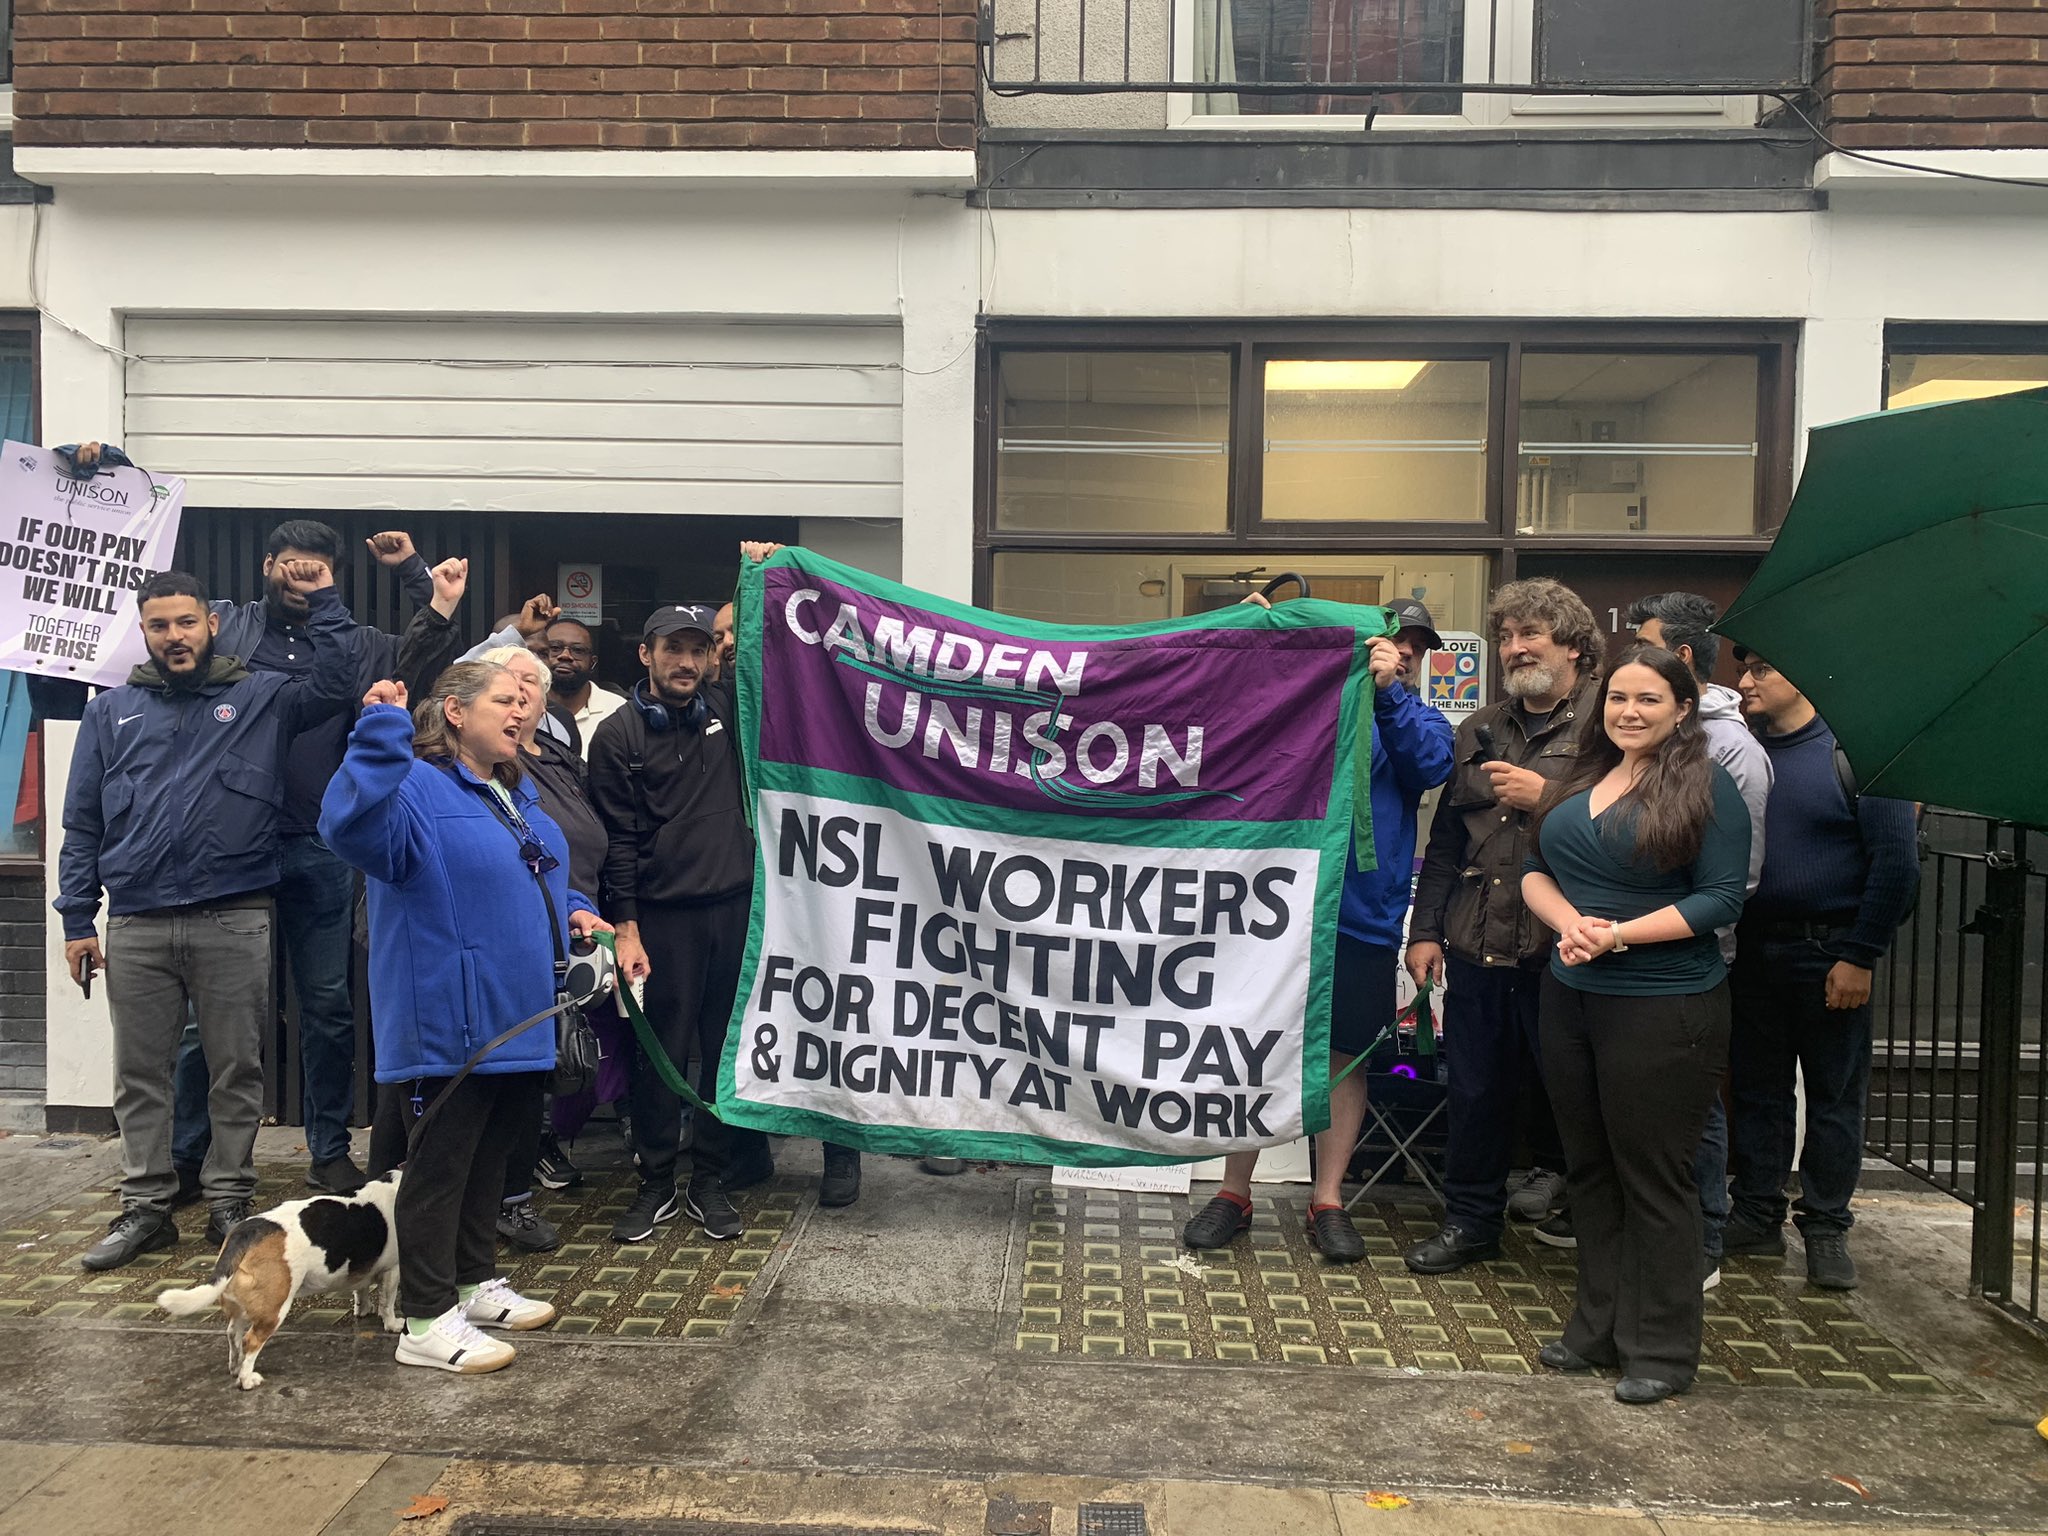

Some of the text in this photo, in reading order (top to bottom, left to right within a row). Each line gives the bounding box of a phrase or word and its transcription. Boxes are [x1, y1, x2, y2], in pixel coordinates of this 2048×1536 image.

[55, 477, 129, 505] UNISON
[17, 516, 147, 563] IF OUR PAY
[0, 541, 101, 583] DOESN'T
[22, 575, 118, 615] WE WILL
[23, 632, 98, 662] WE RISE
[28, 614, 102, 642] TOGETHER
[785, 588, 1088, 696] CAMDEN
[1442, 642, 1477, 652] LOVE
[1431, 700, 1476, 709] THE NHS
[864, 682, 1204, 788] UNISON
[779, 808, 1297, 940] NSL WORKERS
[850, 896, 1216, 1009] FIGHTING
[758, 955, 1283, 1086] FOR DECENT PAY
[750, 1022, 1274, 1137] & DIGNITY AT WORK
